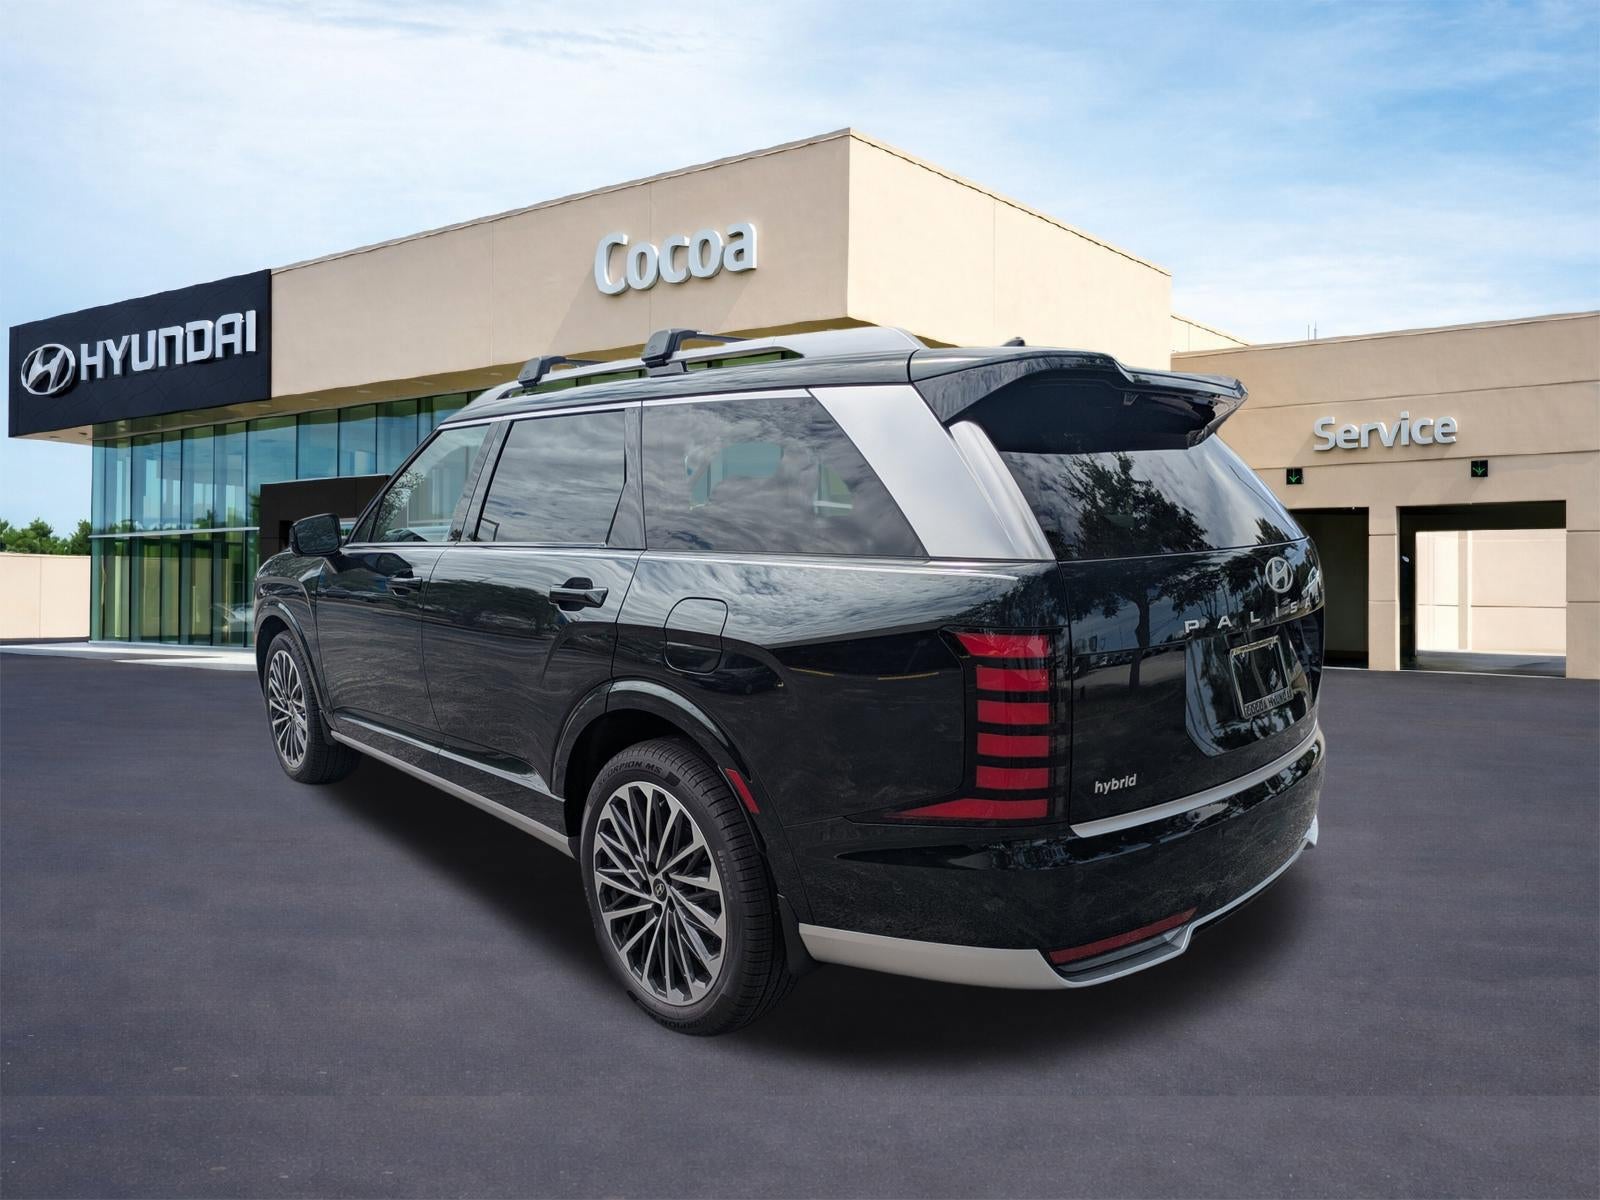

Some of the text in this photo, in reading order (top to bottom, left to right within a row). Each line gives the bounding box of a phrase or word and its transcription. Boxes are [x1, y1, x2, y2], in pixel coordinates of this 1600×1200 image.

[594, 223, 757, 295] Cocoa
[80, 310, 256, 381] HYUNDAI
[1313, 411, 1458, 451] Service
[1094, 773, 1137, 795] hybrid
